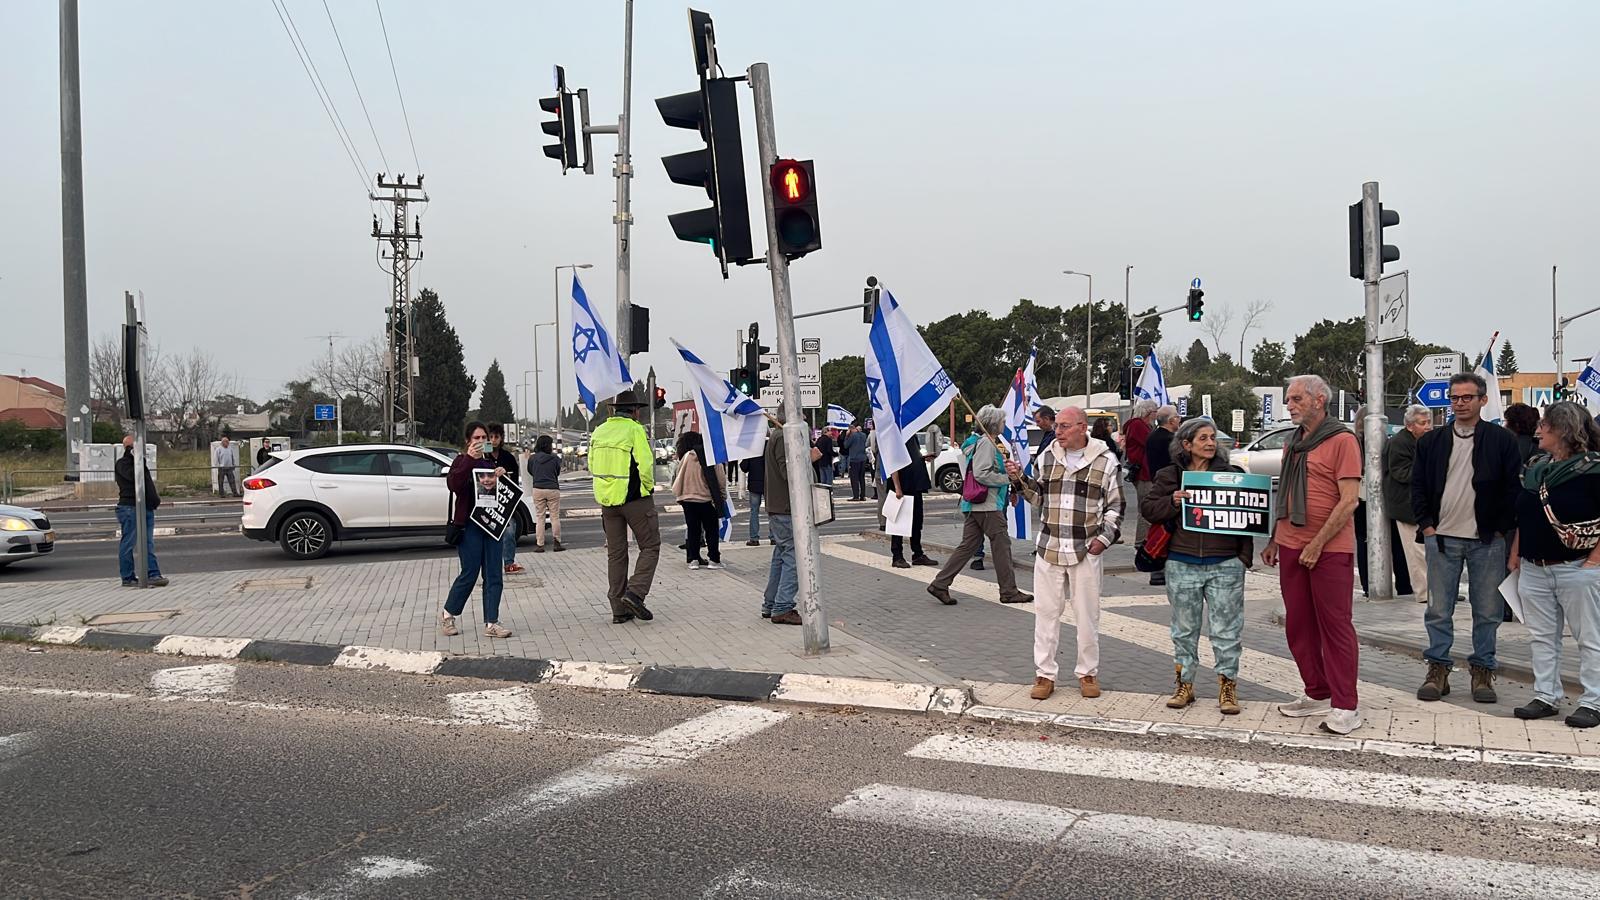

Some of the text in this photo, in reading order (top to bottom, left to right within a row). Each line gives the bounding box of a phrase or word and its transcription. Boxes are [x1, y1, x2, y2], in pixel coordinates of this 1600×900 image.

[1185, 489, 1268, 508] כמה דם עוד
[1192, 507, 1262, 530] יישפך?
